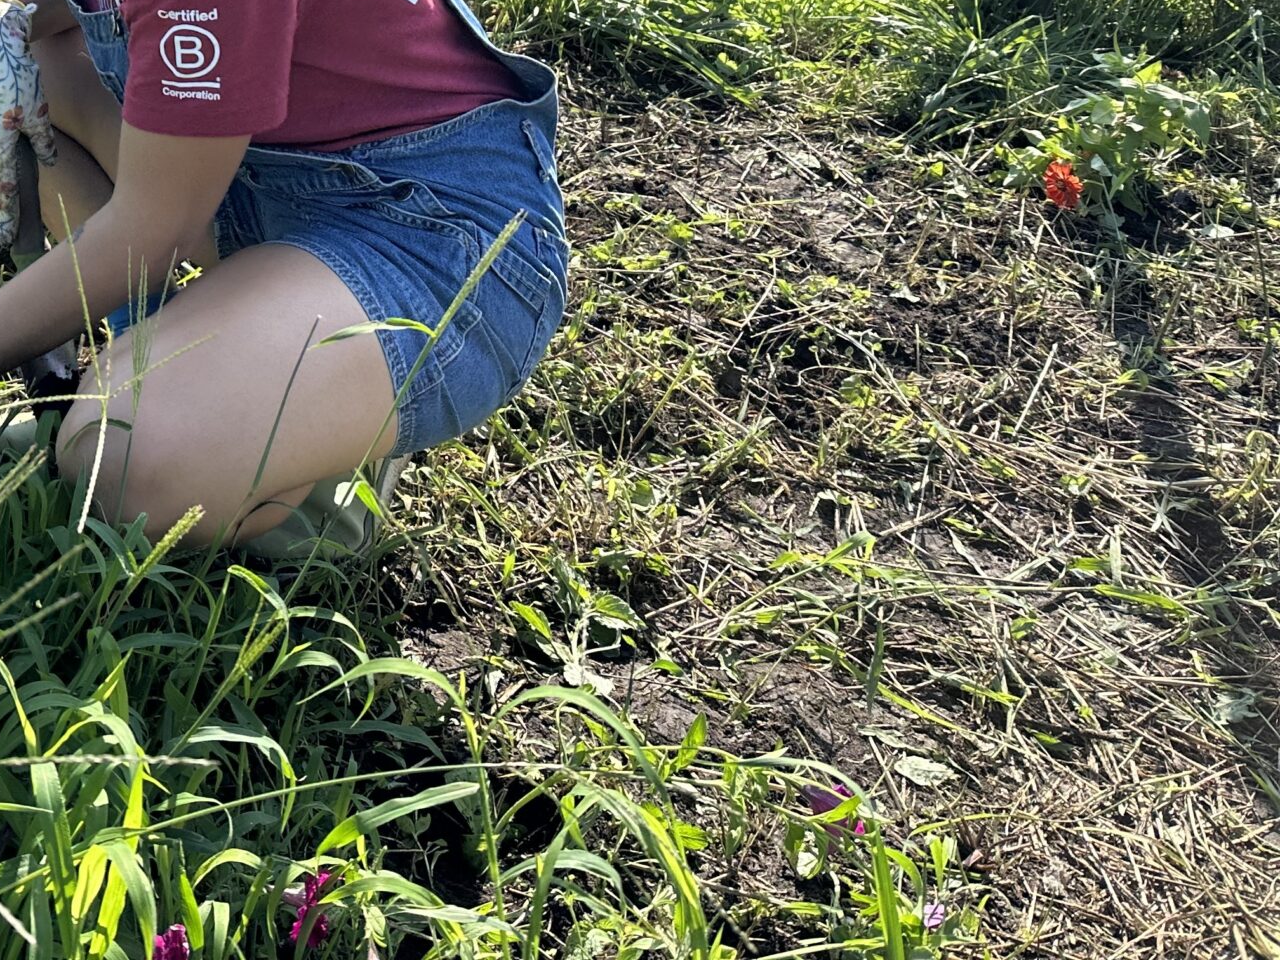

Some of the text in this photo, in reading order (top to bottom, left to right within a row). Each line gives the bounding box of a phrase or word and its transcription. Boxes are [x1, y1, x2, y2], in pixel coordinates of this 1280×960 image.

[157, 7, 219, 22] Certified
[173, 35, 205, 69] B
[161, 86, 221, 101] Corporation
